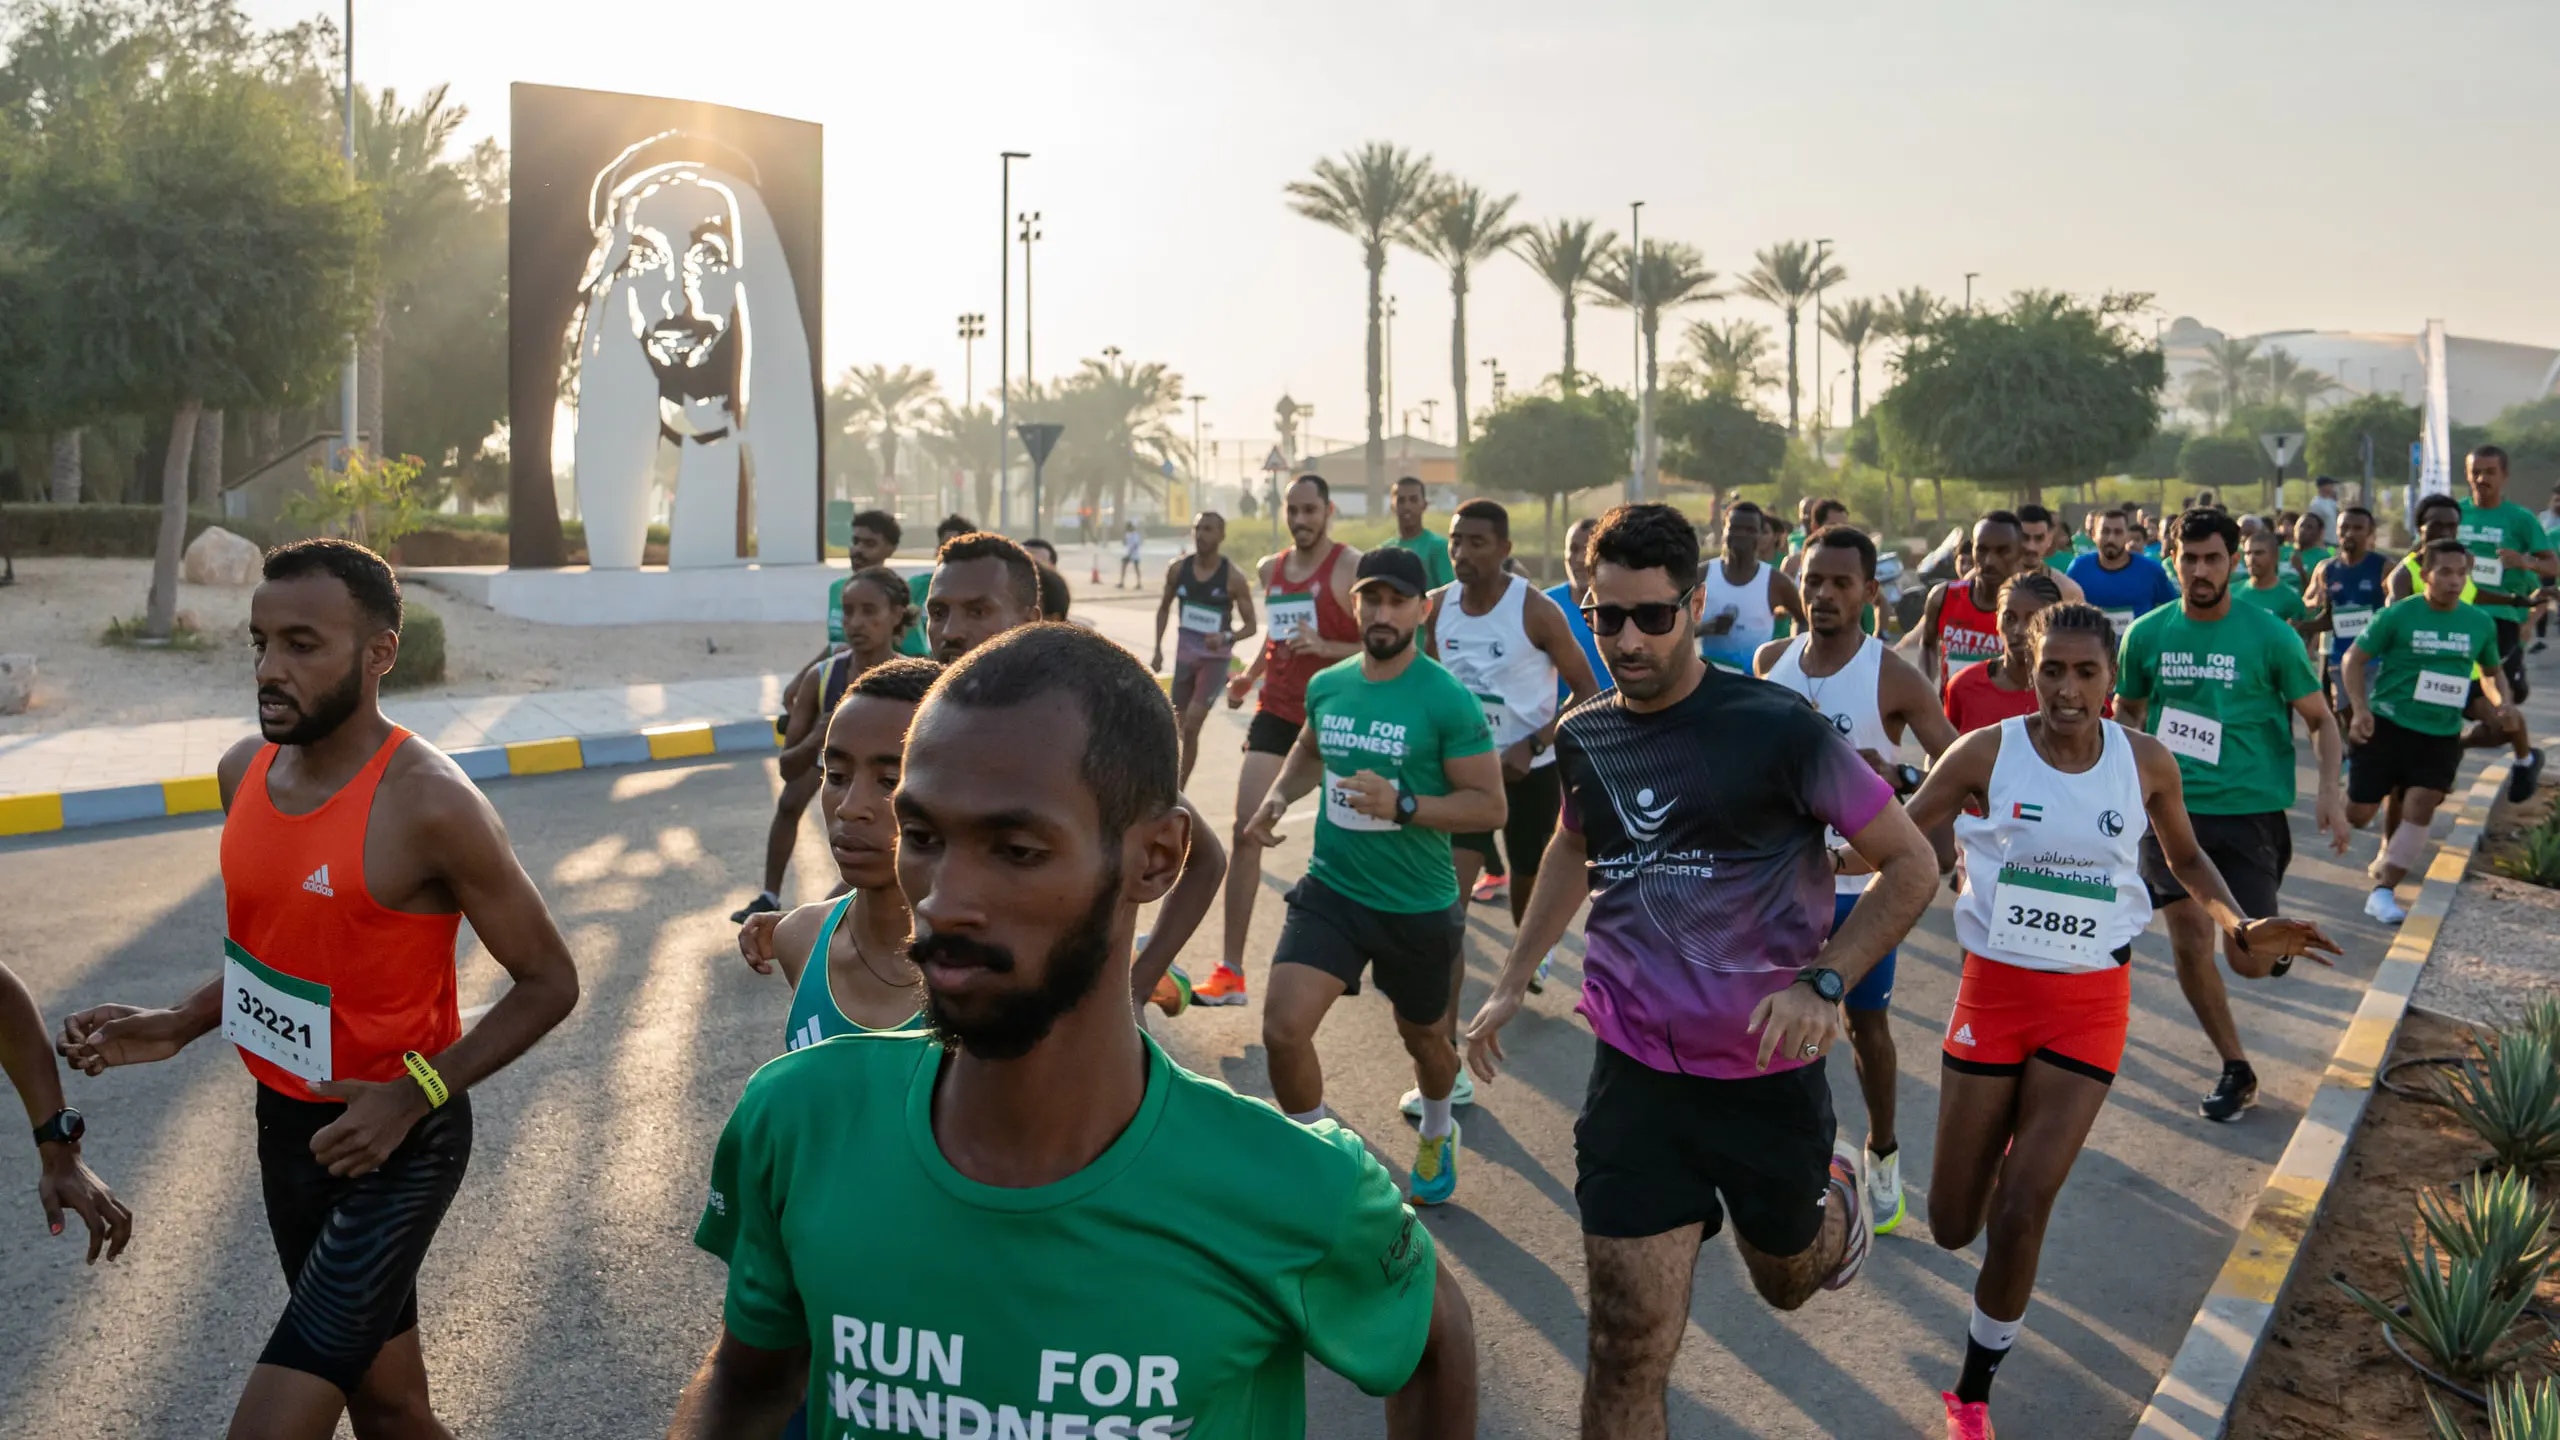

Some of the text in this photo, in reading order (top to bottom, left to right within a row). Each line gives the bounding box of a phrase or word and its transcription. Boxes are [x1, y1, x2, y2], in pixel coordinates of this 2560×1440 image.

[1943, 624, 2004, 651] PATTA
[2161, 652, 2236, 668] RUN FOR
[2161, 665, 2235, 681] KINDNESS
[1321, 714, 1406, 740] RUN FOR
[2168, 721, 2215, 746] 32142
[1319, 730, 1404, 757] KINDNESS
[302, 881, 334, 897] adidas
[2007, 904, 2097, 939] 32882
[237, 987, 312, 1049] 32221
[832, 1314, 1181, 1408] RUN FOR
